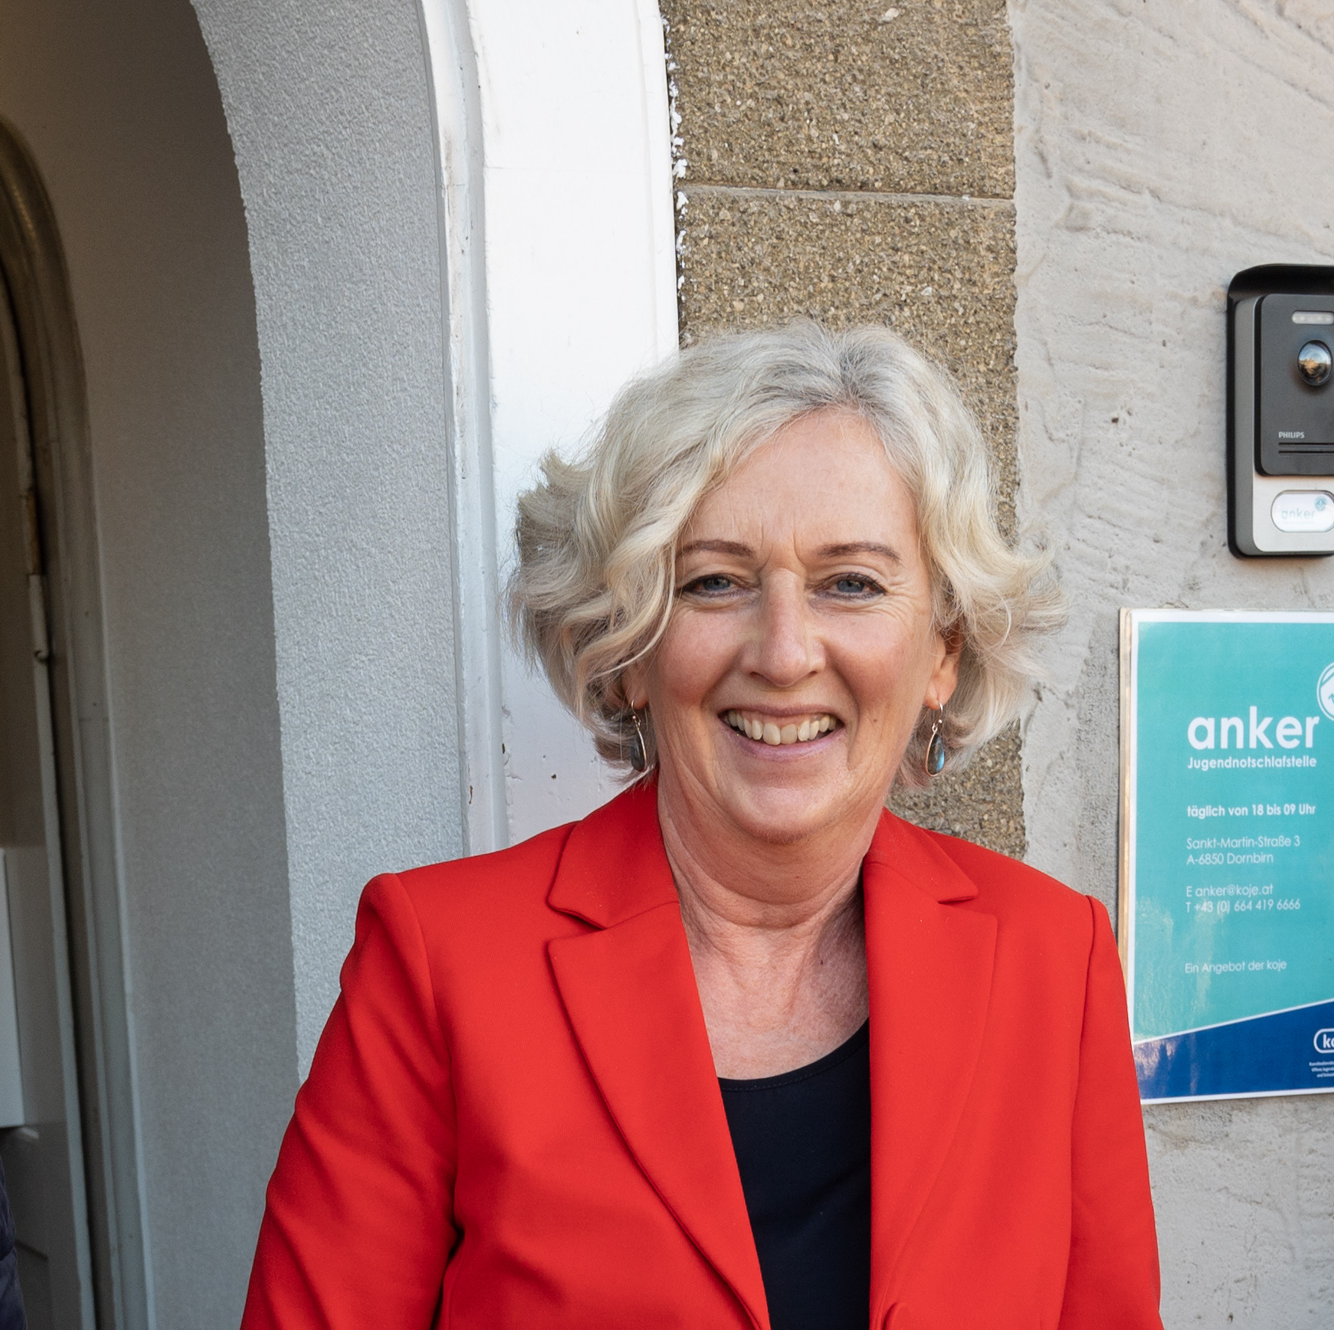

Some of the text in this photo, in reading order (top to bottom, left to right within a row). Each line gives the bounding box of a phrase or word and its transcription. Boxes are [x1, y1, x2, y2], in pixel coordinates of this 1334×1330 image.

[1278, 431, 1305, 439] PHILIPS
[1281, 508, 1316, 520] anker
[1187, 705, 1320, 750] anker
[1187, 755, 1317, 772] Jugendnotschlafstelle
[1187, 803, 1316, 819] täglich von 18 bis 09 Uhr
[1186, 835, 1301, 849] Sankt-Martin-Straße 3
[1186, 852, 1274, 865] A-6850 Dornbirn
[1186, 883, 1274, 898] E anker@koje.at
[1186, 902, 1192, 913] T
[1194, 901, 1214, 912] +43
[1216, 900, 1231, 914] (0)
[1233, 900, 1253, 912] 664
[1276, 898, 1301, 910] 6666
[1185, 959, 1287, 975] Ein Angebot der koje
